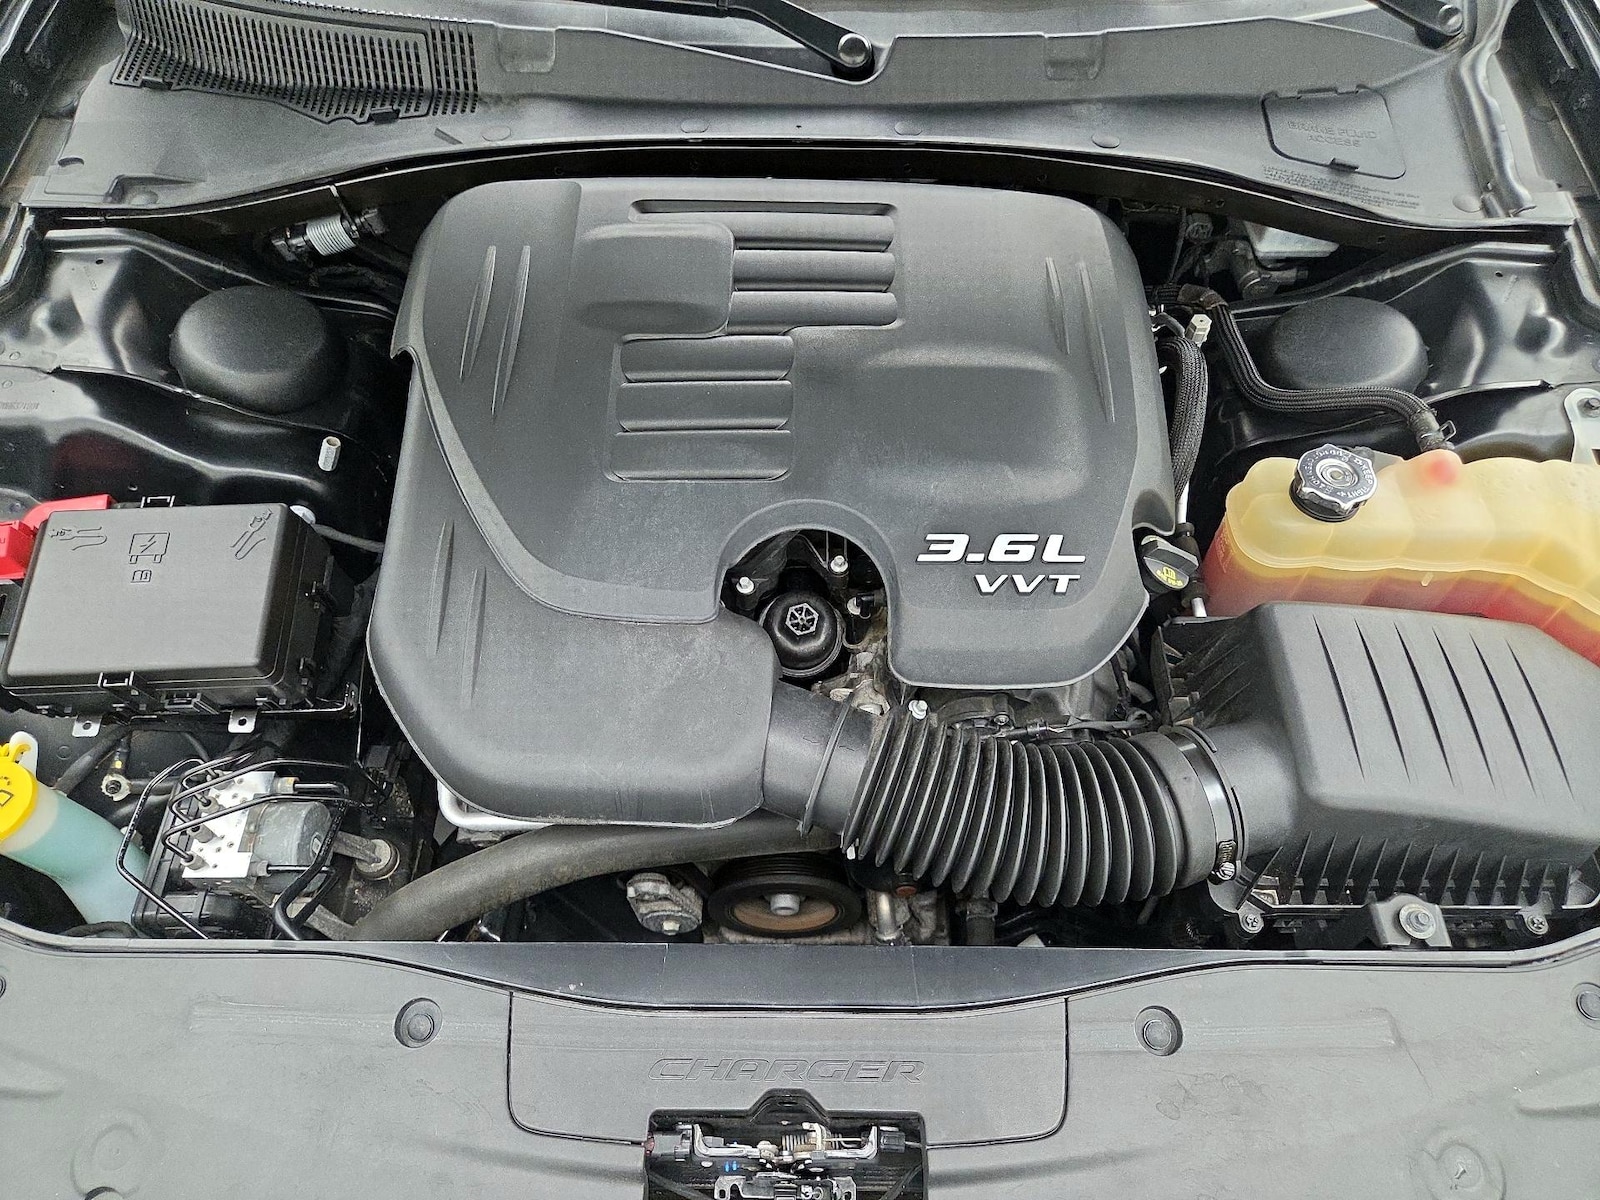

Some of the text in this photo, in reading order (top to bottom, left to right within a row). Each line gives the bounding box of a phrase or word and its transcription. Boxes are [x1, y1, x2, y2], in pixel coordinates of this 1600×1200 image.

[1339, 129, 1377, 139] FLUID
[1347, 463, 1374, 499] KEEP TIGHT
[916, 533, 1086, 564] 3.6L
[974, 574, 1081, 596] VVT
[648, 1058, 925, 1084] CHARGER
